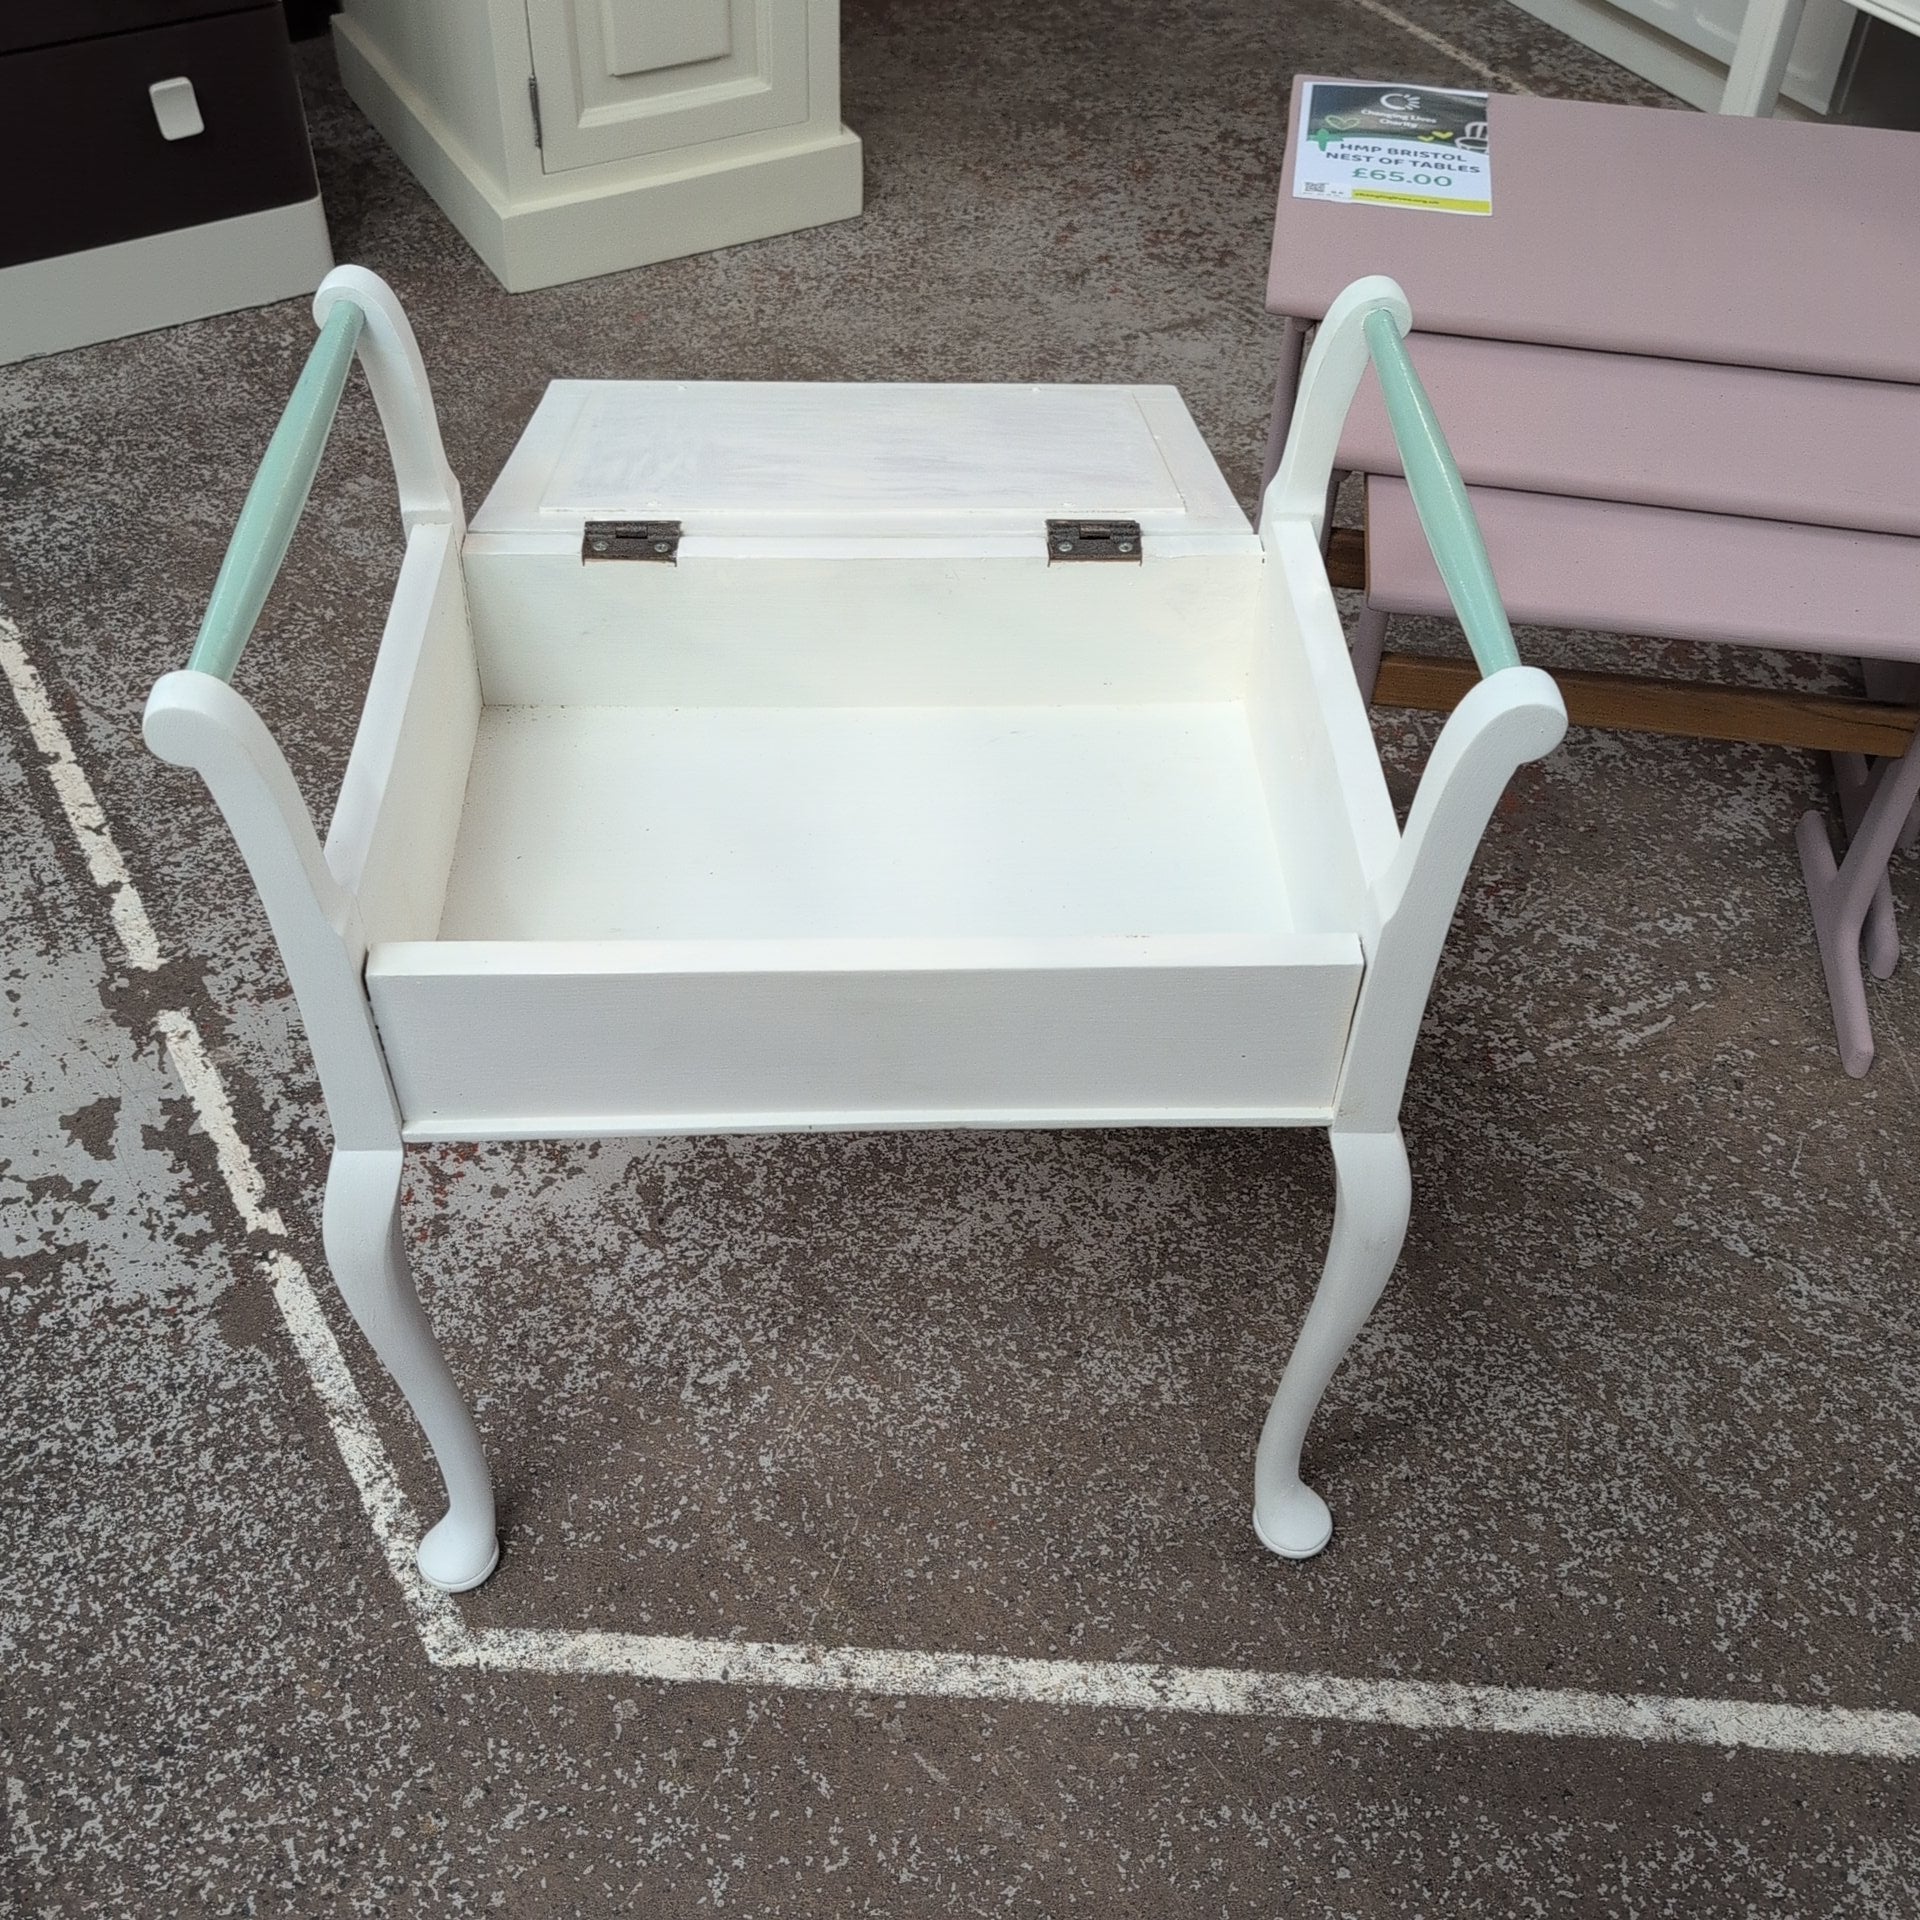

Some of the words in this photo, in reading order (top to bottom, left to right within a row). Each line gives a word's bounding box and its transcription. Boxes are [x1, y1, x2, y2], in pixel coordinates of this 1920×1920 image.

[1379, 119, 1418, 129] Charity
[1410, 115, 1437, 124] Lives
[1340, 143, 1382, 153] HMP
[1387, 147, 1467, 162] BRISTOL
[1326, 152, 1376, 163] NEST
[1379, 156, 1405, 166] OF
[1409, 159, 1481, 174] TABLES
[1352, 167, 1453, 187] £65.00
